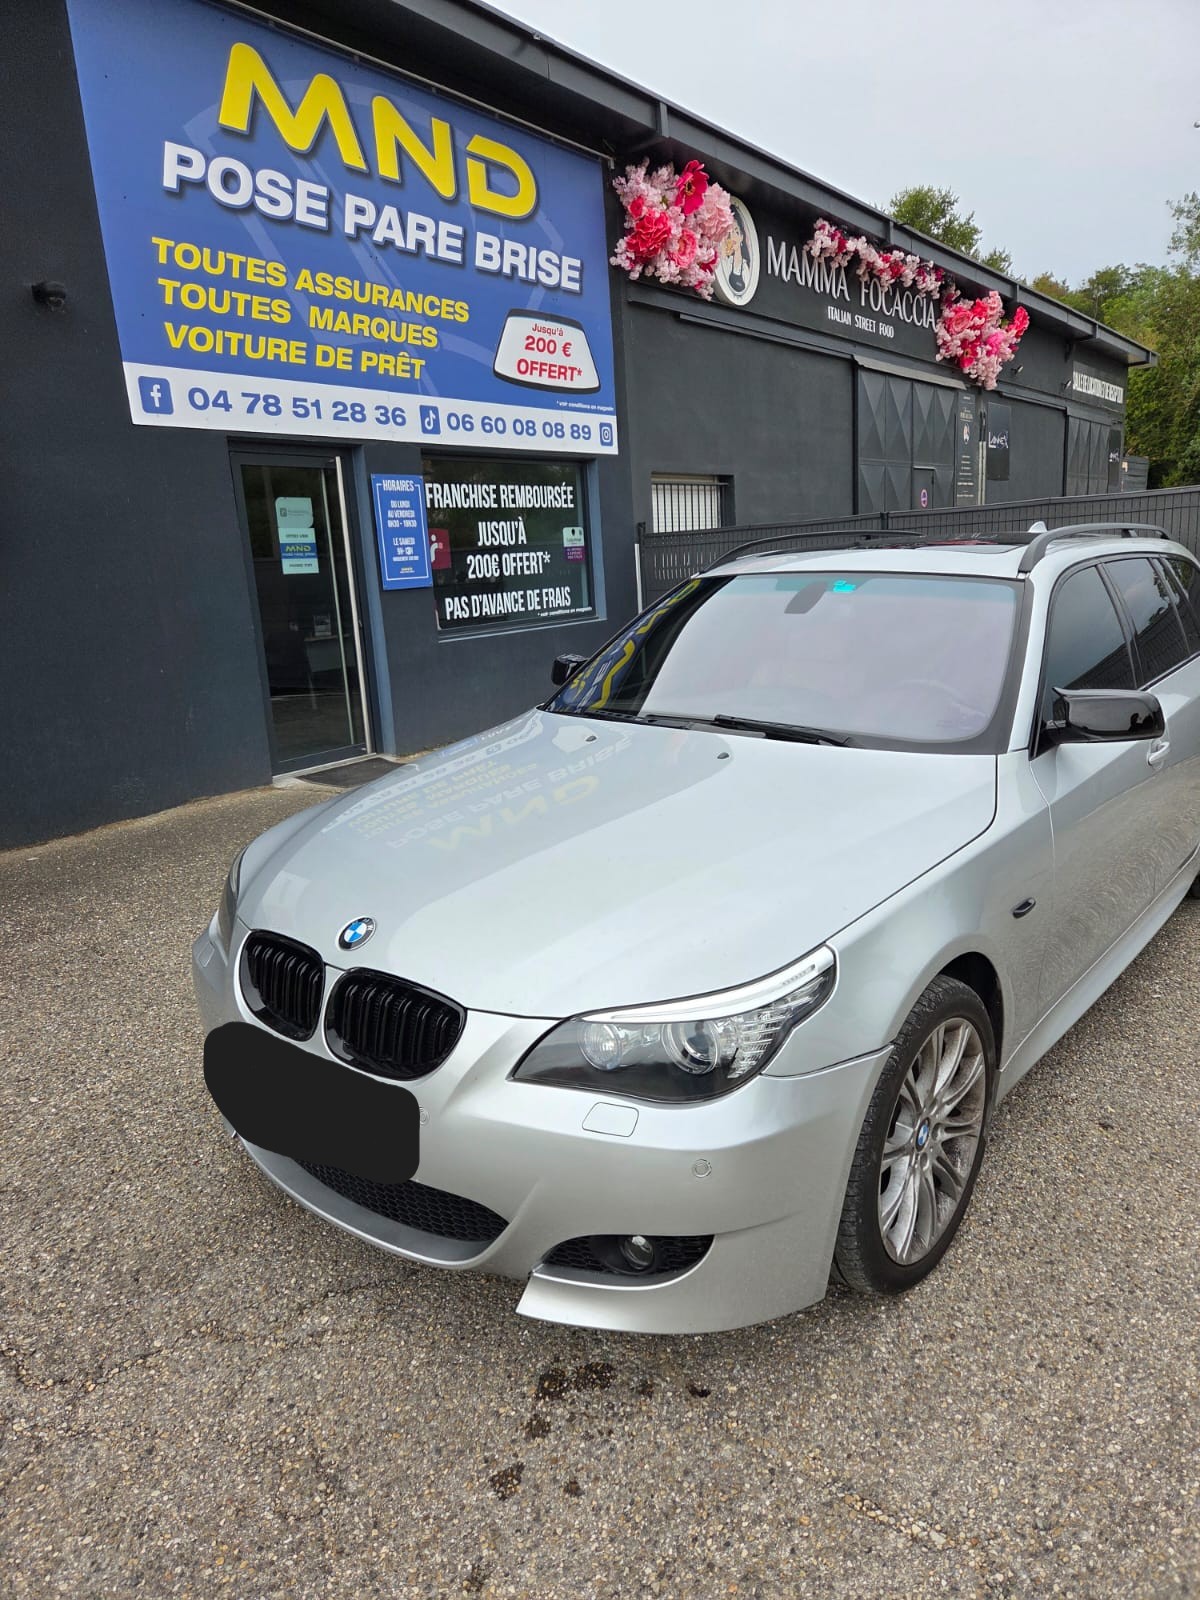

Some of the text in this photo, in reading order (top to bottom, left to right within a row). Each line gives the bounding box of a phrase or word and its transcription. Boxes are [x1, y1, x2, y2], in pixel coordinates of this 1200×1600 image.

[218, 42, 537, 218] MND
[163, 141, 582, 293] POSE PARE BRISE
[152, 237, 470, 323] TOUTES ASSURANCES
[767, 236, 938, 333] MAMMA FOCACCIA
[158, 278, 438, 347] TOUTES MARQUES
[828, 306, 895, 338] ITALIAN STREET FOOD
[164, 322, 425, 380] VOITURE DE PRÊT
[524, 335, 573, 358] 200 €
[188, 387, 407, 427] 04 78 51 28 36
[446, 412, 592, 441] 06 60 08 08 89
[382, 479, 415, 492] HORAIRES
[425, 482, 575, 509] FRANCHISE REMBOURSÉE
[477, 516, 527, 547] JUSQU'À
[467, 553, 500, 579] 200€
[445, 586, 571, 620] PAS D'AVANCE DE FRAIS
